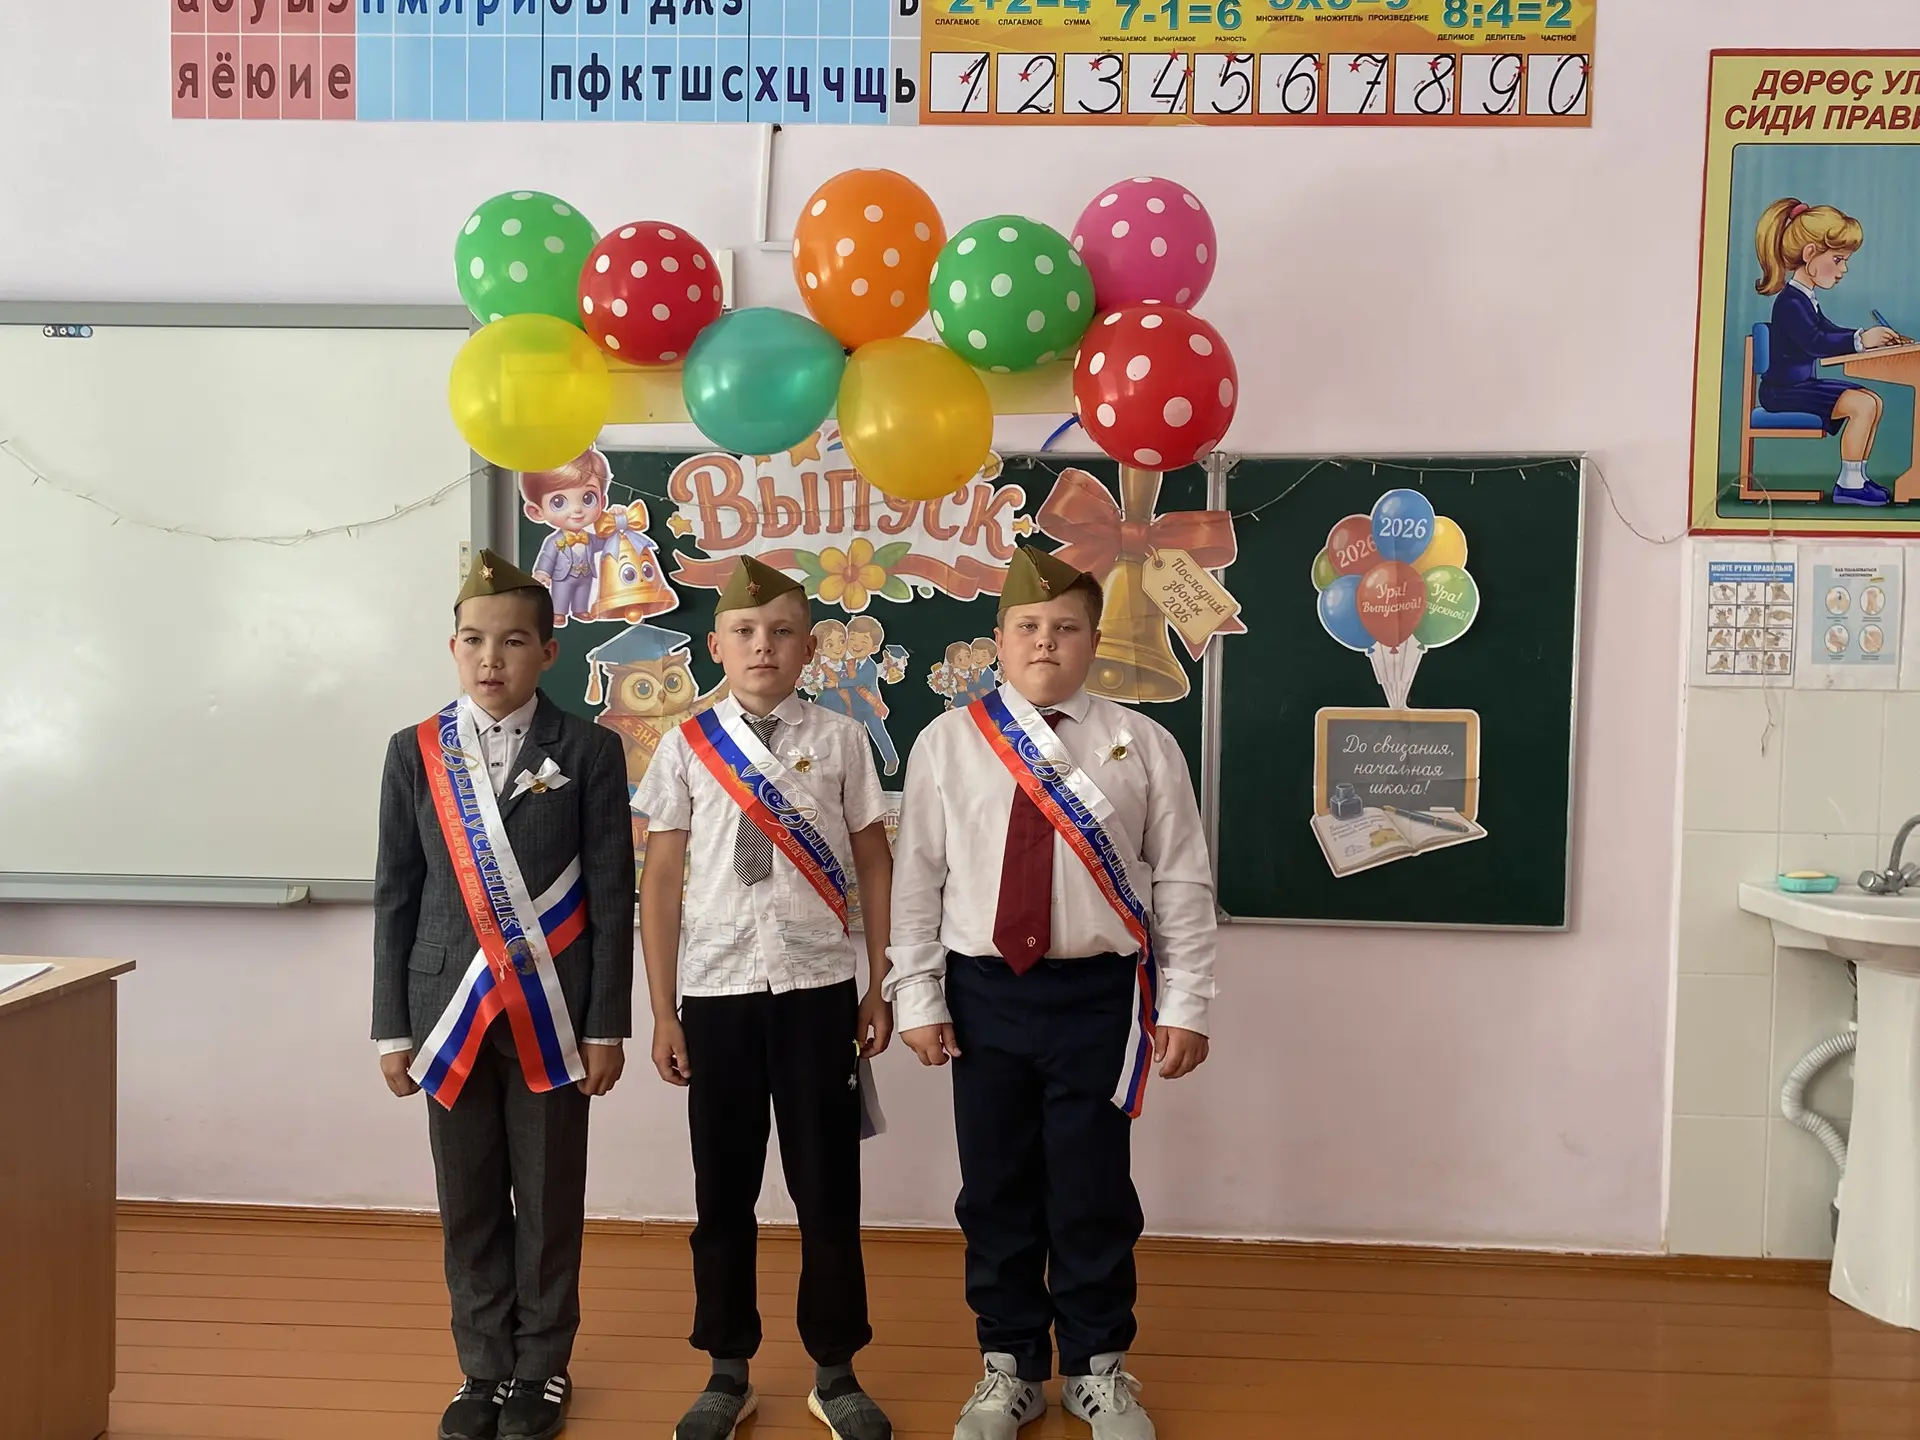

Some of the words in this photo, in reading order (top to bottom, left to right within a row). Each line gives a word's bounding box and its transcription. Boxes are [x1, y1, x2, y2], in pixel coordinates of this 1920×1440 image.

[934, 18, 981, 26] СЛАГАЕМОЕ
[997, 18, 1043, 26] СЛАГАЕМОЕ
[1063, 18, 1091, 26] СУММА
[1255, 14, 1304, 22] МНОЖИТЕЛЬ
[1315, 14, 1363, 22] МНОЖИТЕЛЬ
[1368, 14, 1429, 22] ПРОИЗВЕДЕНИЕ
[964, 53, 990, 113] 1
[1017, 55, 1056, 114] 2
[1078, 54, 1123, 114] 3
[1150, 53, 1193, 114] 4
[1211, 53, 1254, 114] 5
[1282, 54, 1320, 114] 6
[1351, 54, 1389, 115] 7
[1414, 54, 1456, 115] 8
[1482, 54, 1523, 115] 9
[1548, 54, 1589, 116] 0
[1724, 104, 1817, 136] СИДИ
[1379, 517, 1428, 539] 2026
[1336, 534, 1378, 568] 2026
[1162, 580, 1204, 616] звонок
[1171, 557, 1228, 616] Последний
[1430, 583, 1463, 604] Ура!
[1162, 596, 1193, 624] 2026
[632, 724, 658, 750] ЗНА
[1342, 734, 1368, 753] До
[1373, 734, 1454, 761] свидания,
